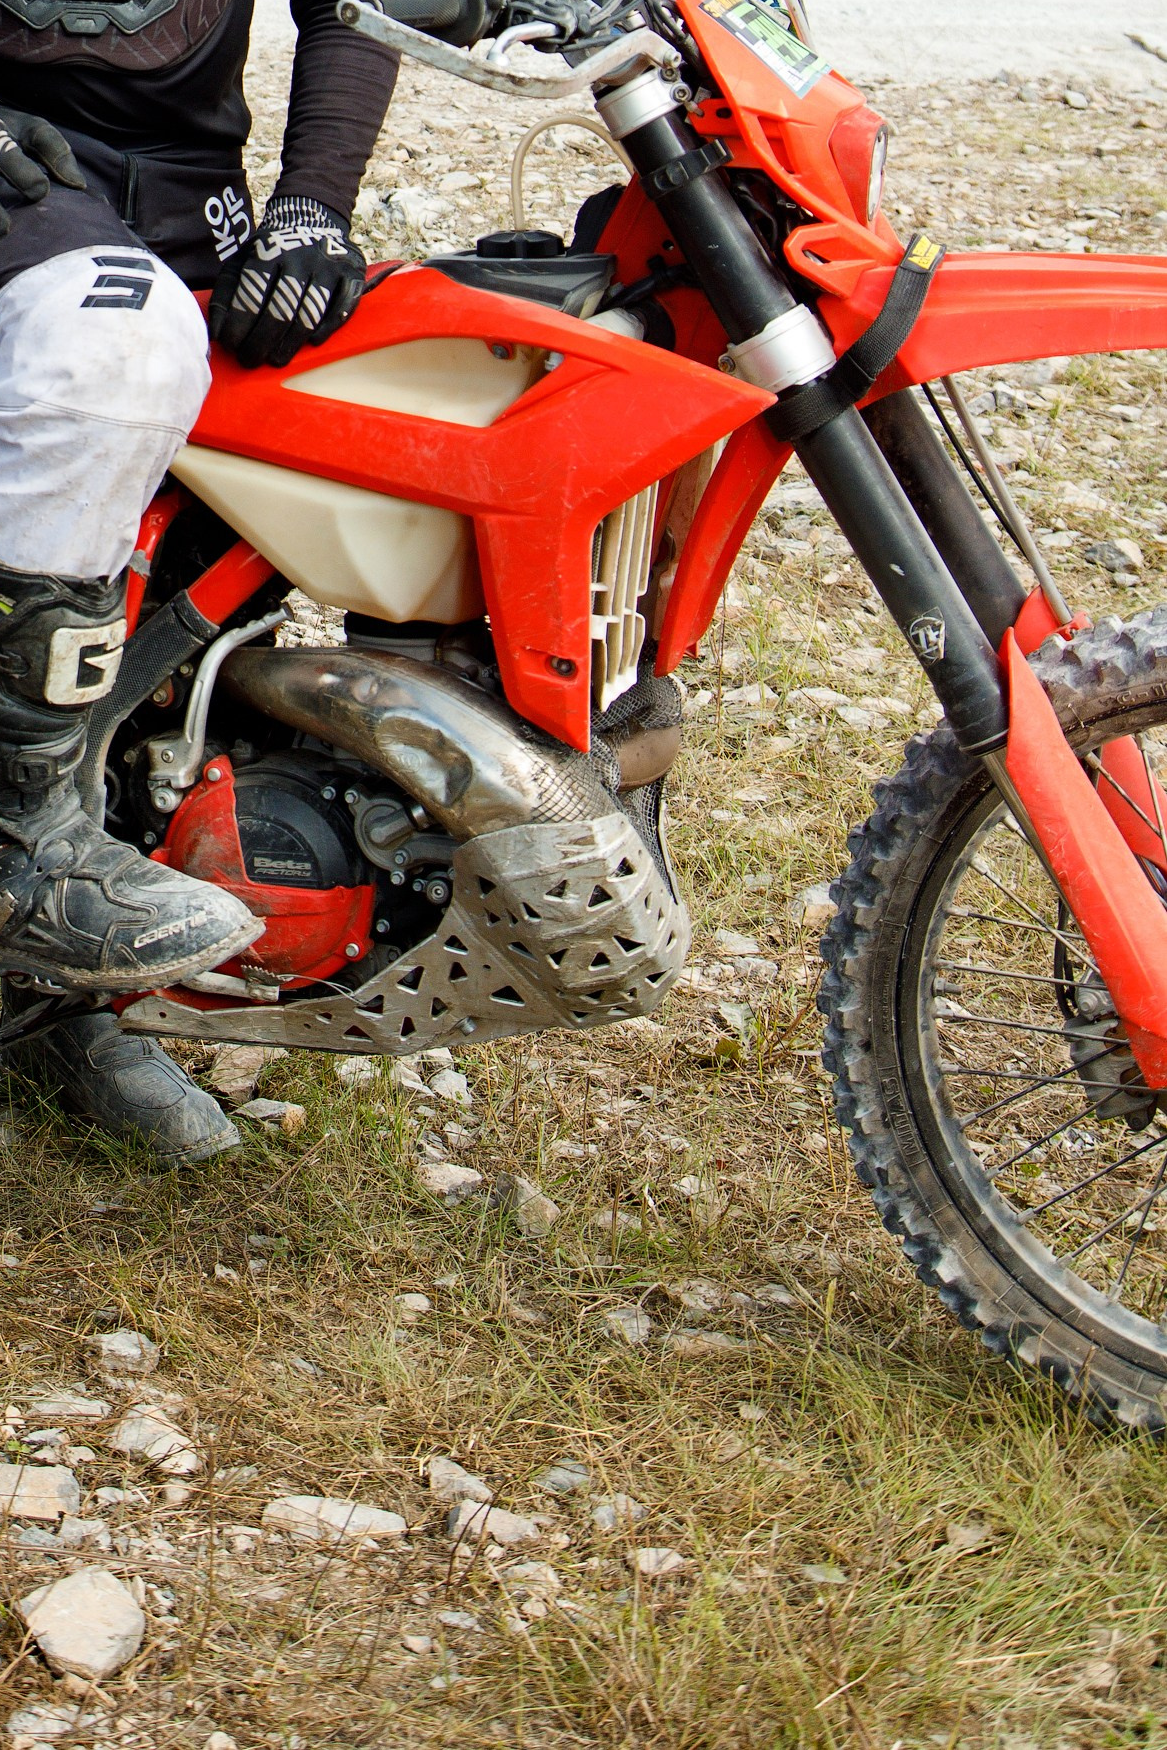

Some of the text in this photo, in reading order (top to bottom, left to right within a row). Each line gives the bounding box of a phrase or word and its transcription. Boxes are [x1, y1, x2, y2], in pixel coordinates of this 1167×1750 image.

[204, 196, 239, 262] IKO
[253, 856, 312, 871] Beta
[253, 867, 312, 878] FACTORY
